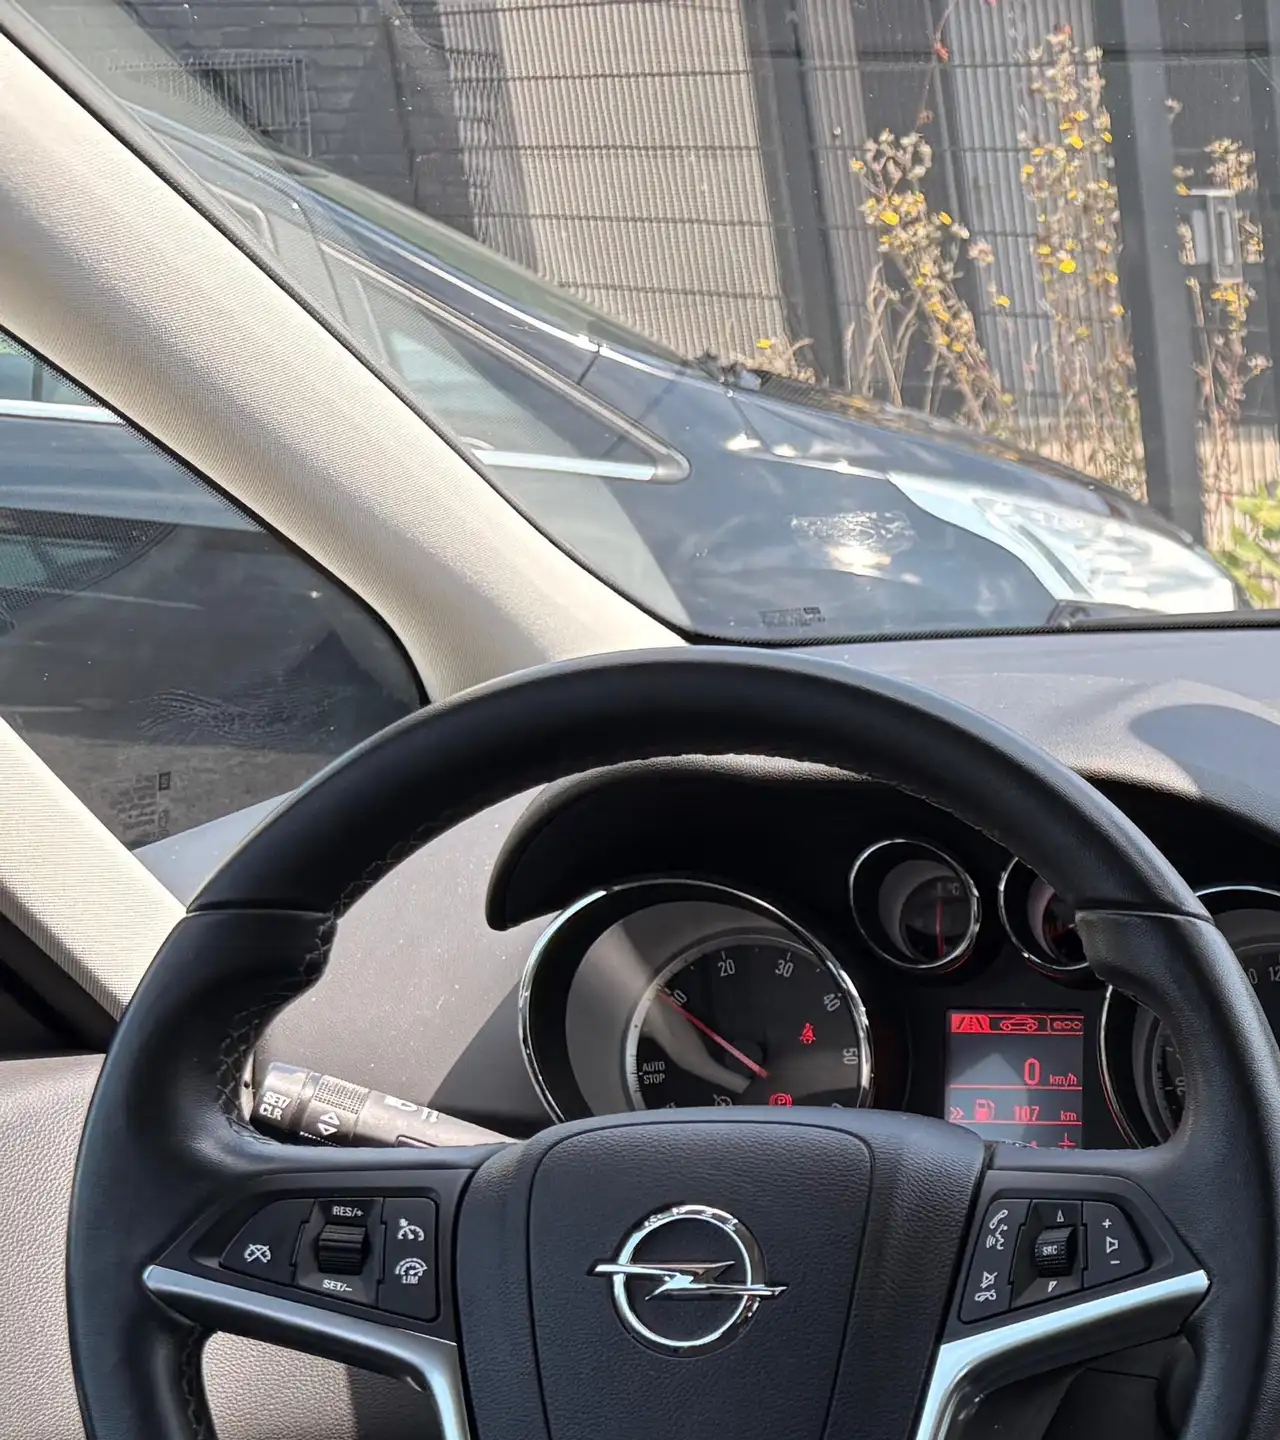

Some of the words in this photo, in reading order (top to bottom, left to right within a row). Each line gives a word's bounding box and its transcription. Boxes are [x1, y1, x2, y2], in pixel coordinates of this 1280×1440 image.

[719, 959, 736, 977] 20
[775, 959, 793, 977] 30
[823, 993, 840, 1011] 40
[1053, 1021, 1082, 1029] eco
[843, 1048, 858, 1065] 50
[643, 1061, 665, 1072] AUTO
[1024, 1057, 1041, 1085] 0
[1050, 1073, 1077, 1086] km/h
[643, 1074, 665, 1085] STOP
[263, 1091, 291, 1108] SET/
[259, 1104, 283, 1121] CLR
[1014, 1106, 1040, 1121] 107
[1061, 1111, 1077, 1120] km
[332, 1206, 364, 1217] RES/+
[1043, 1246, 1058, 1256] SRC
